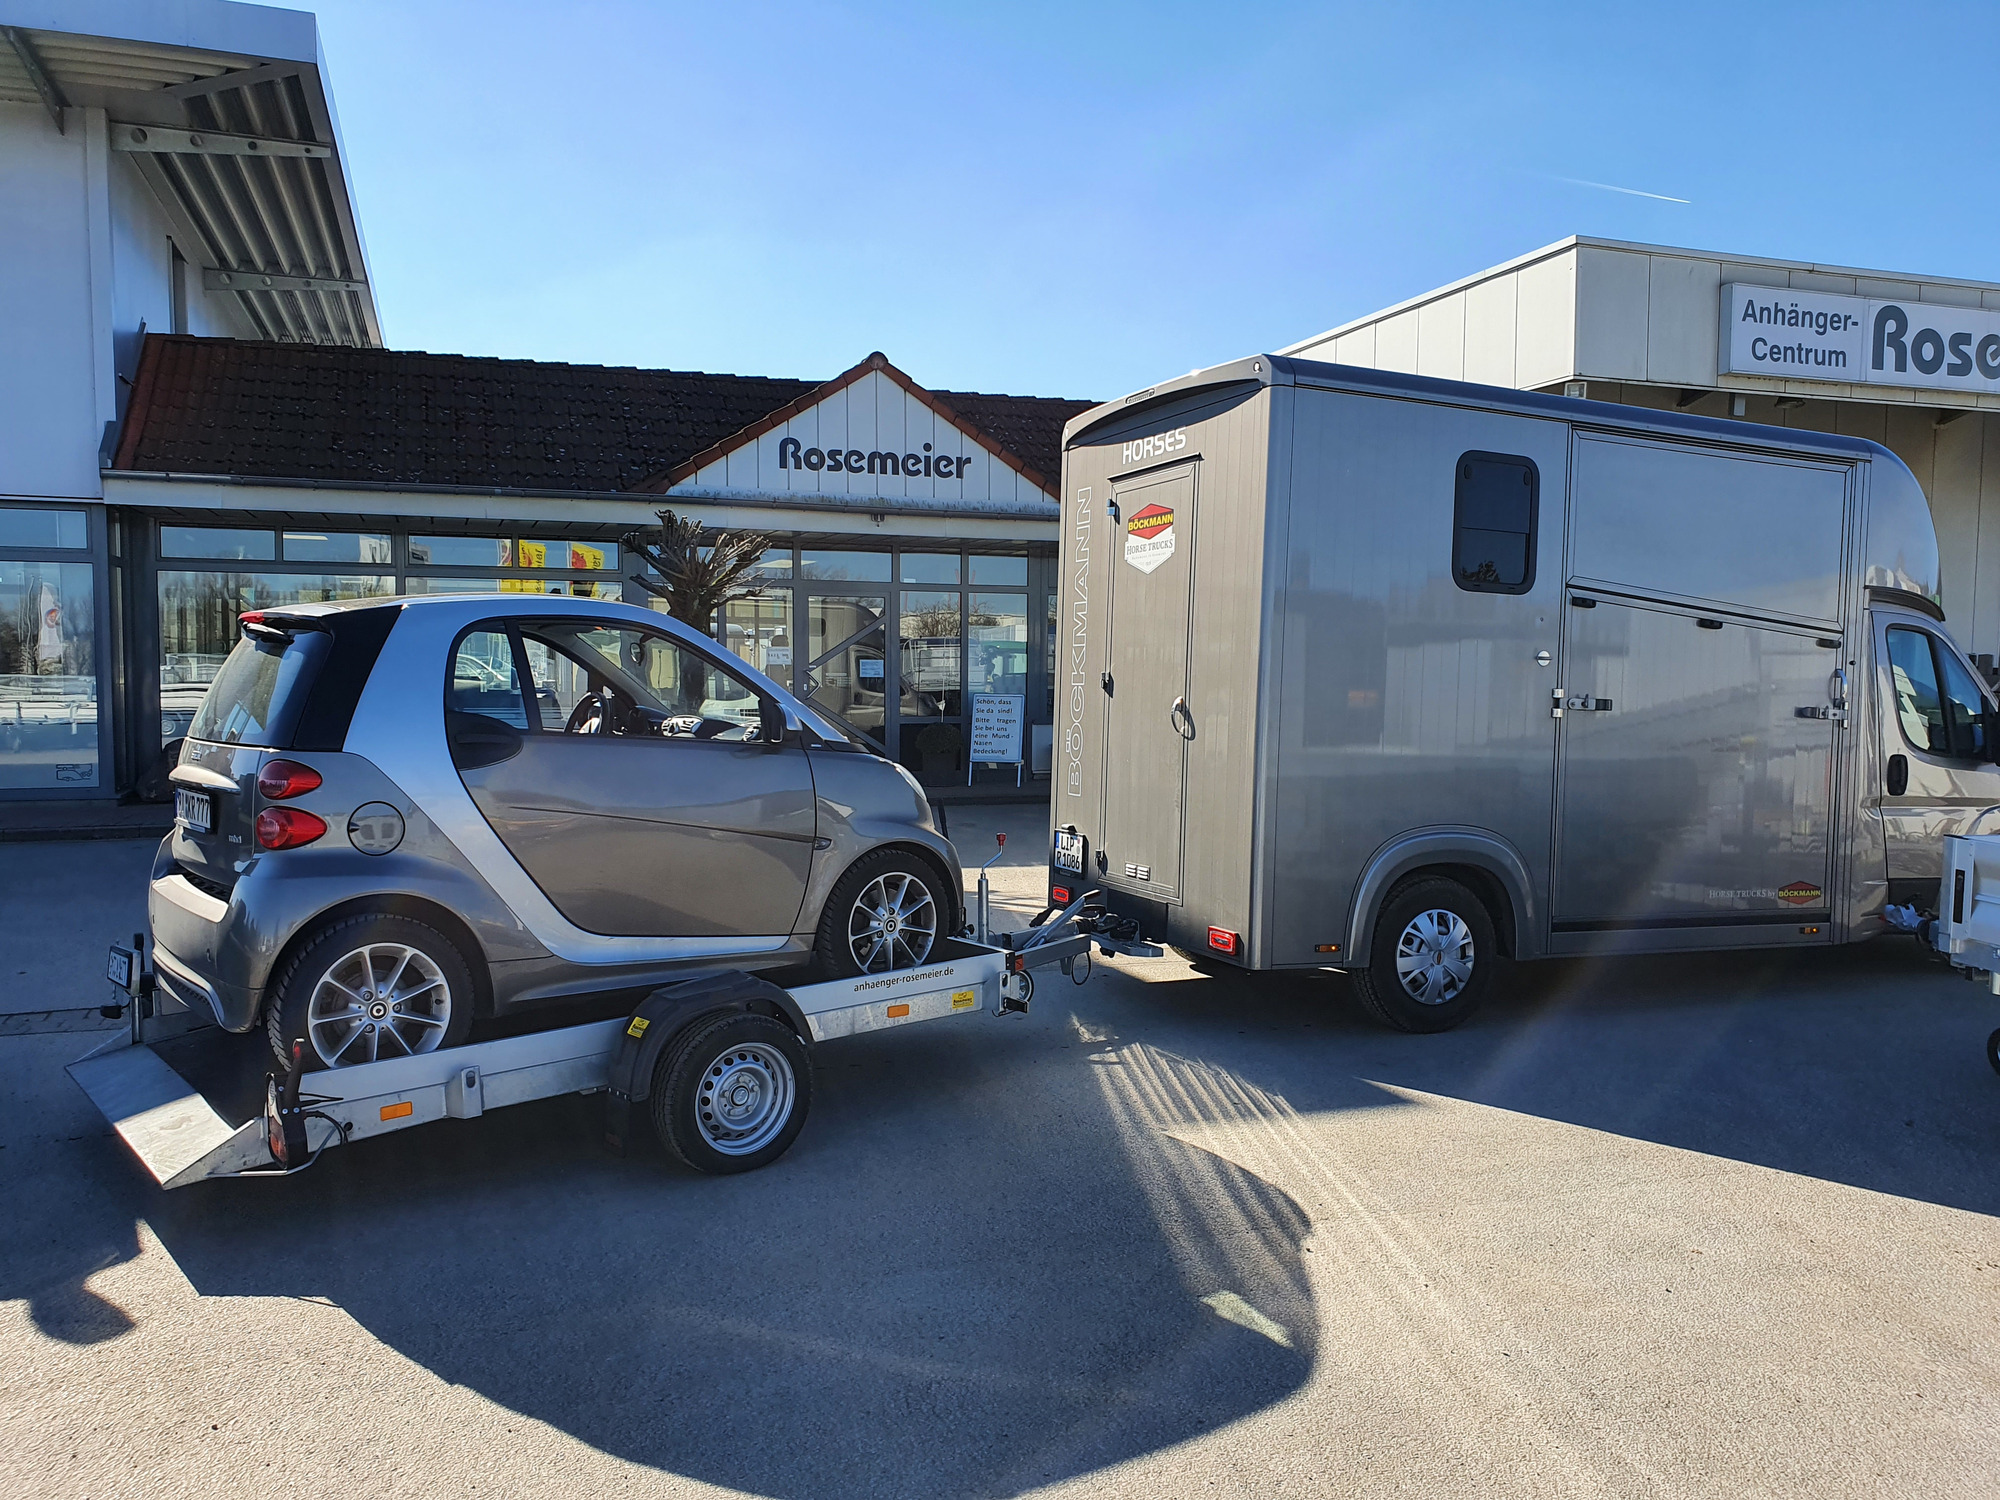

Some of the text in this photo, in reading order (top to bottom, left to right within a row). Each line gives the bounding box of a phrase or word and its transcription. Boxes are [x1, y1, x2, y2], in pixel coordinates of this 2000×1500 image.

[1741, 299, 1859, 335] Anhänger-
[1751, 337, 1847, 368] Centrum
[778, 436, 972, 480] Rosemeier
[1122, 426, 1188, 465] HORSES
[1128, 513, 1174, 531] BÖCKMANN
[1126, 538, 1174, 556] HORSE TRUCKS
[1066, 486, 1092, 797] BÖCKMANN
[1060, 835, 1075, 851] LIP
[1778, 889, 1821, 898] BÖCKMANN
[853, 966, 955, 992] anhaenger-rosemeier.de
